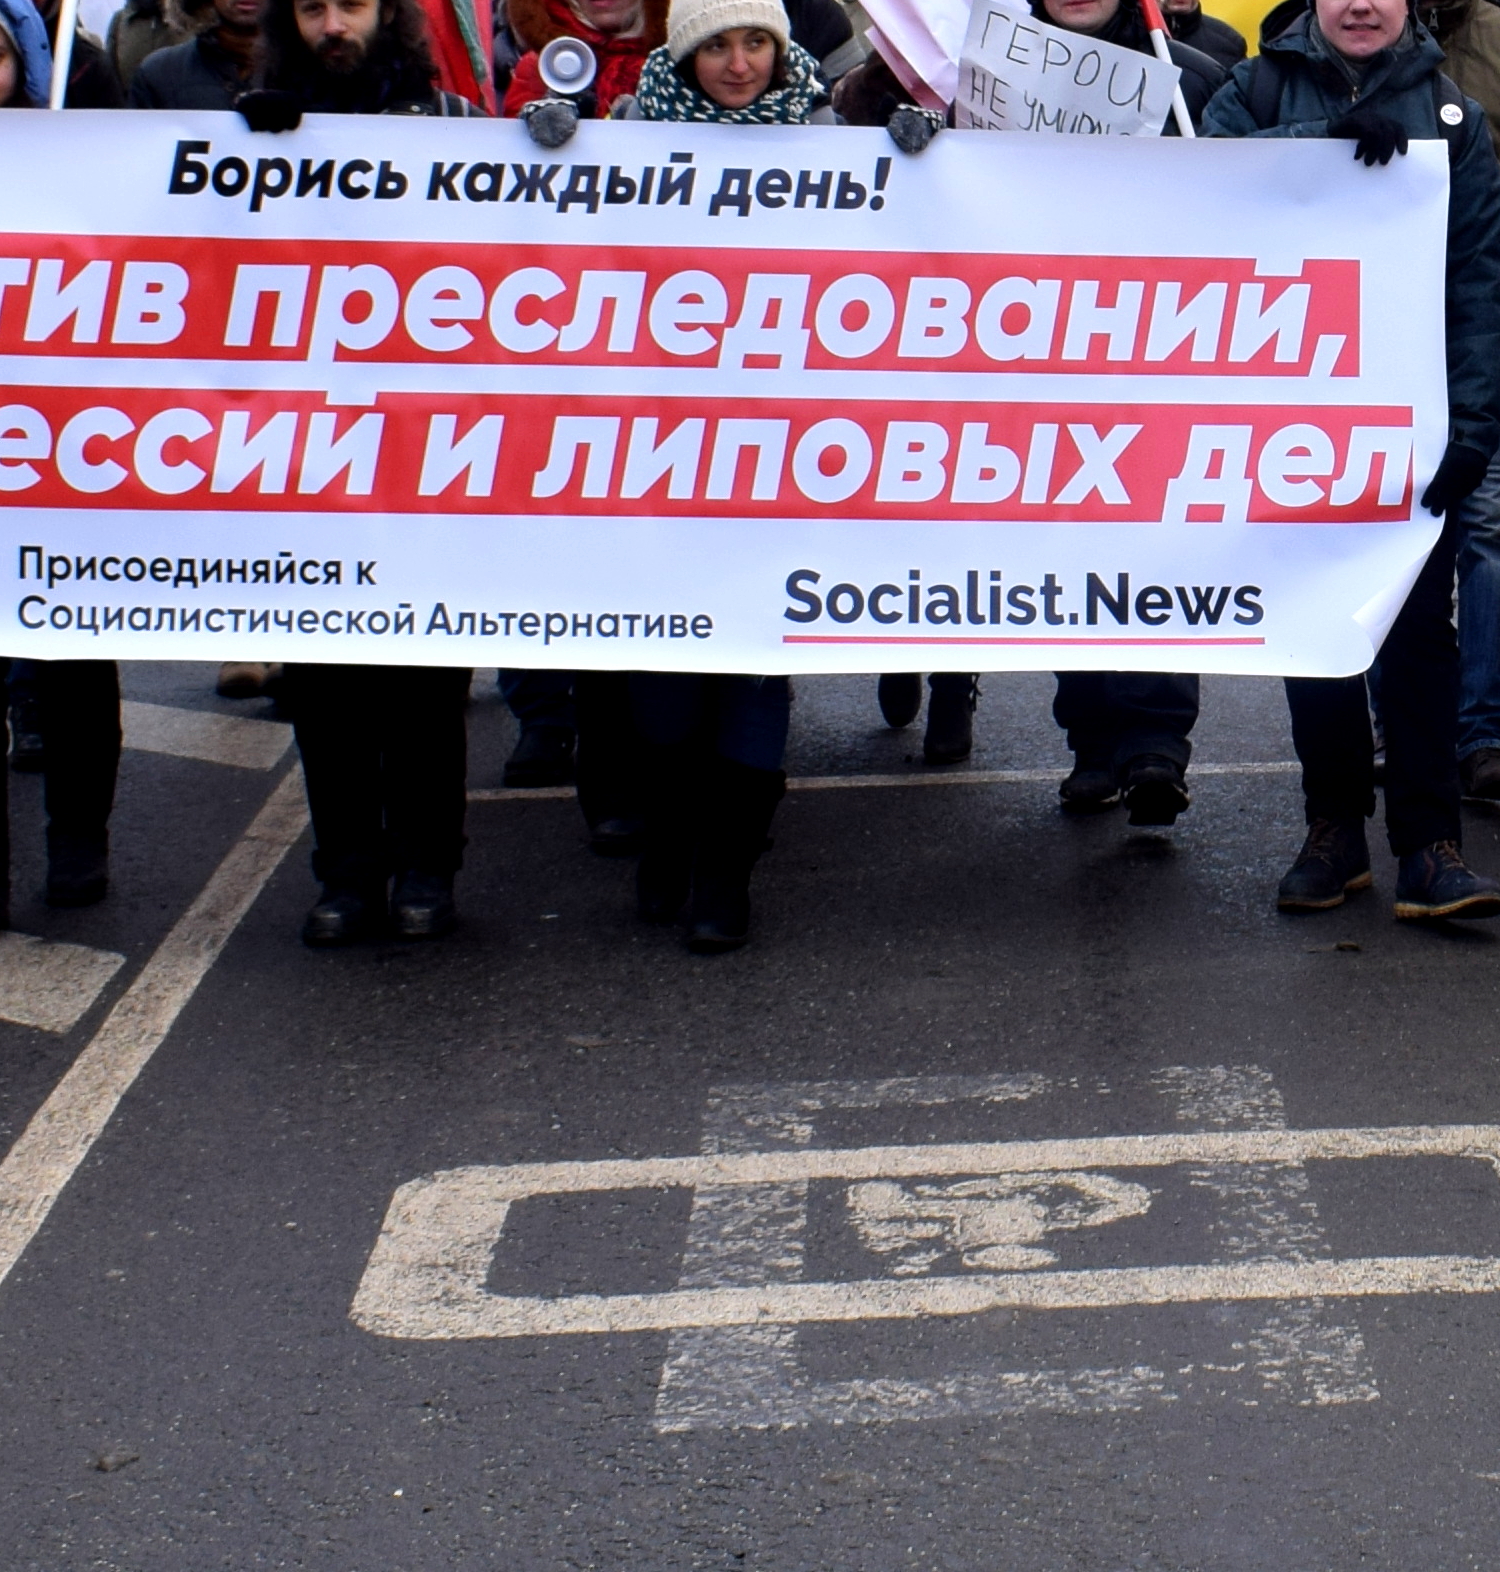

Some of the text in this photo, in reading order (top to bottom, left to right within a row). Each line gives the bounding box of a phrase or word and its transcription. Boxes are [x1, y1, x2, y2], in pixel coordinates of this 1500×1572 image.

[971, 67, 1011, 118] НЕ
[980, 11, 1147, 113] ГЕРОИ
[168, 140, 892, 216] Борись каждый день!
[224, 260, 1348, 375] преследований,
[418, 415, 504, 497] и
[533, 416, 1142, 506] липовых
[1163, 424, 1412, 521] дел
[18, 545, 377, 588] Присоединяйся к
[783, 569, 1265, 625] Socialist.News
[16, 596, 713, 644] Социалистической Альтернативе
